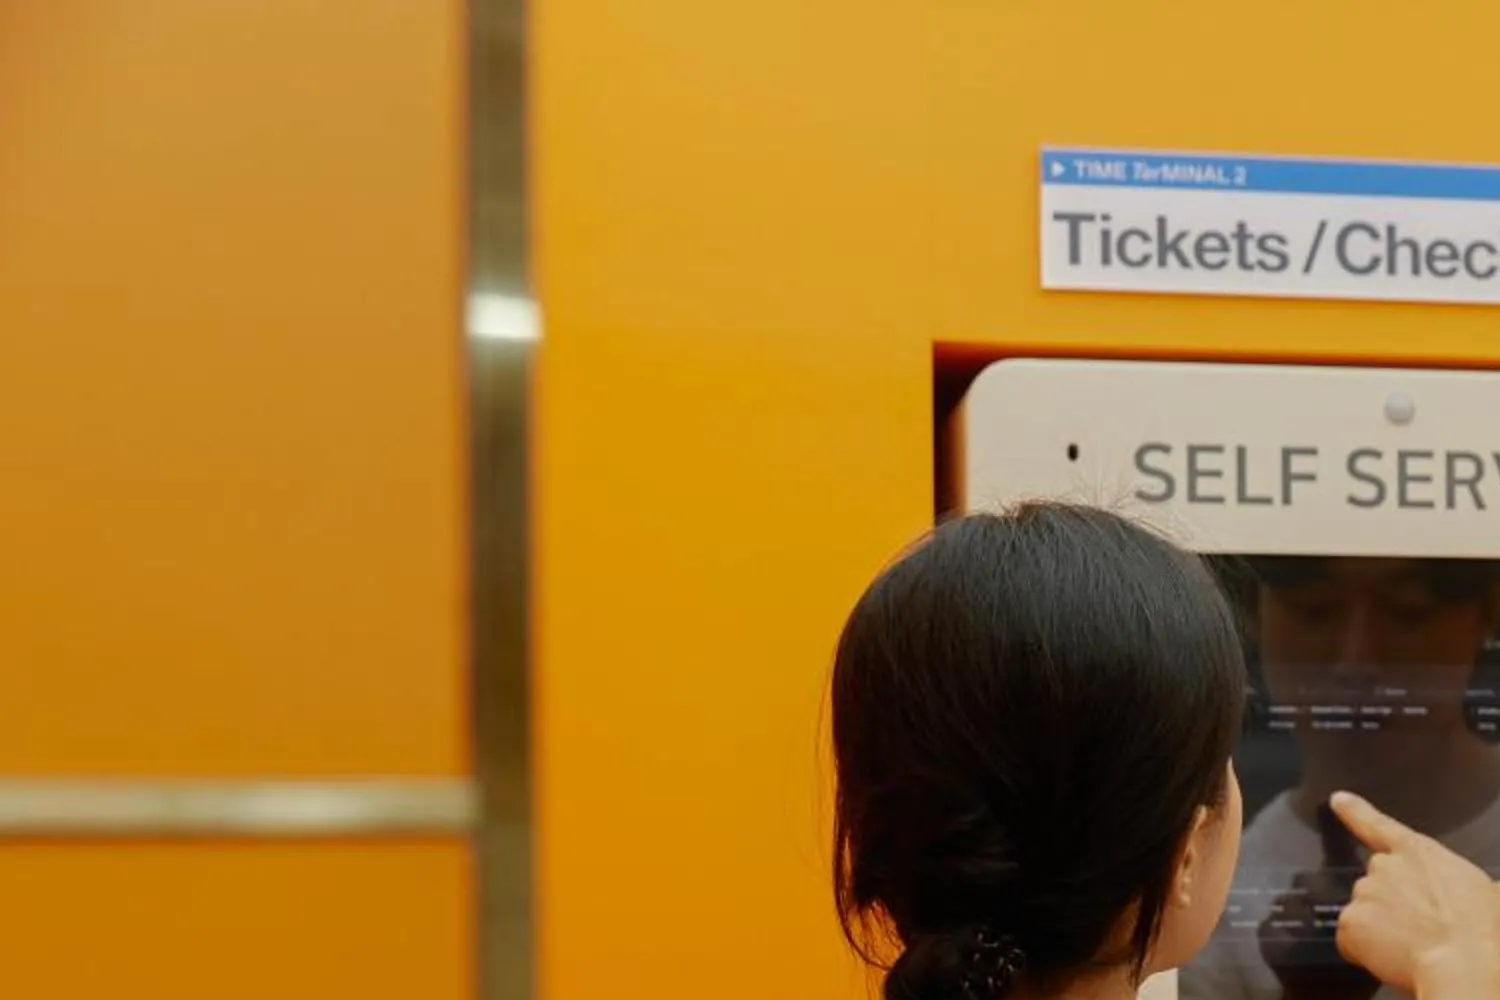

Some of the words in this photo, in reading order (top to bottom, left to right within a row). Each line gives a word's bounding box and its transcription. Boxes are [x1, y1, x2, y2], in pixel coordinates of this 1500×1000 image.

[1073, 159, 1127, 181] TIME
[1233, 165, 1247, 186] 2
[1053, 211, 1290, 274] Tickets
[1133, 442, 1319, 506] SELF
